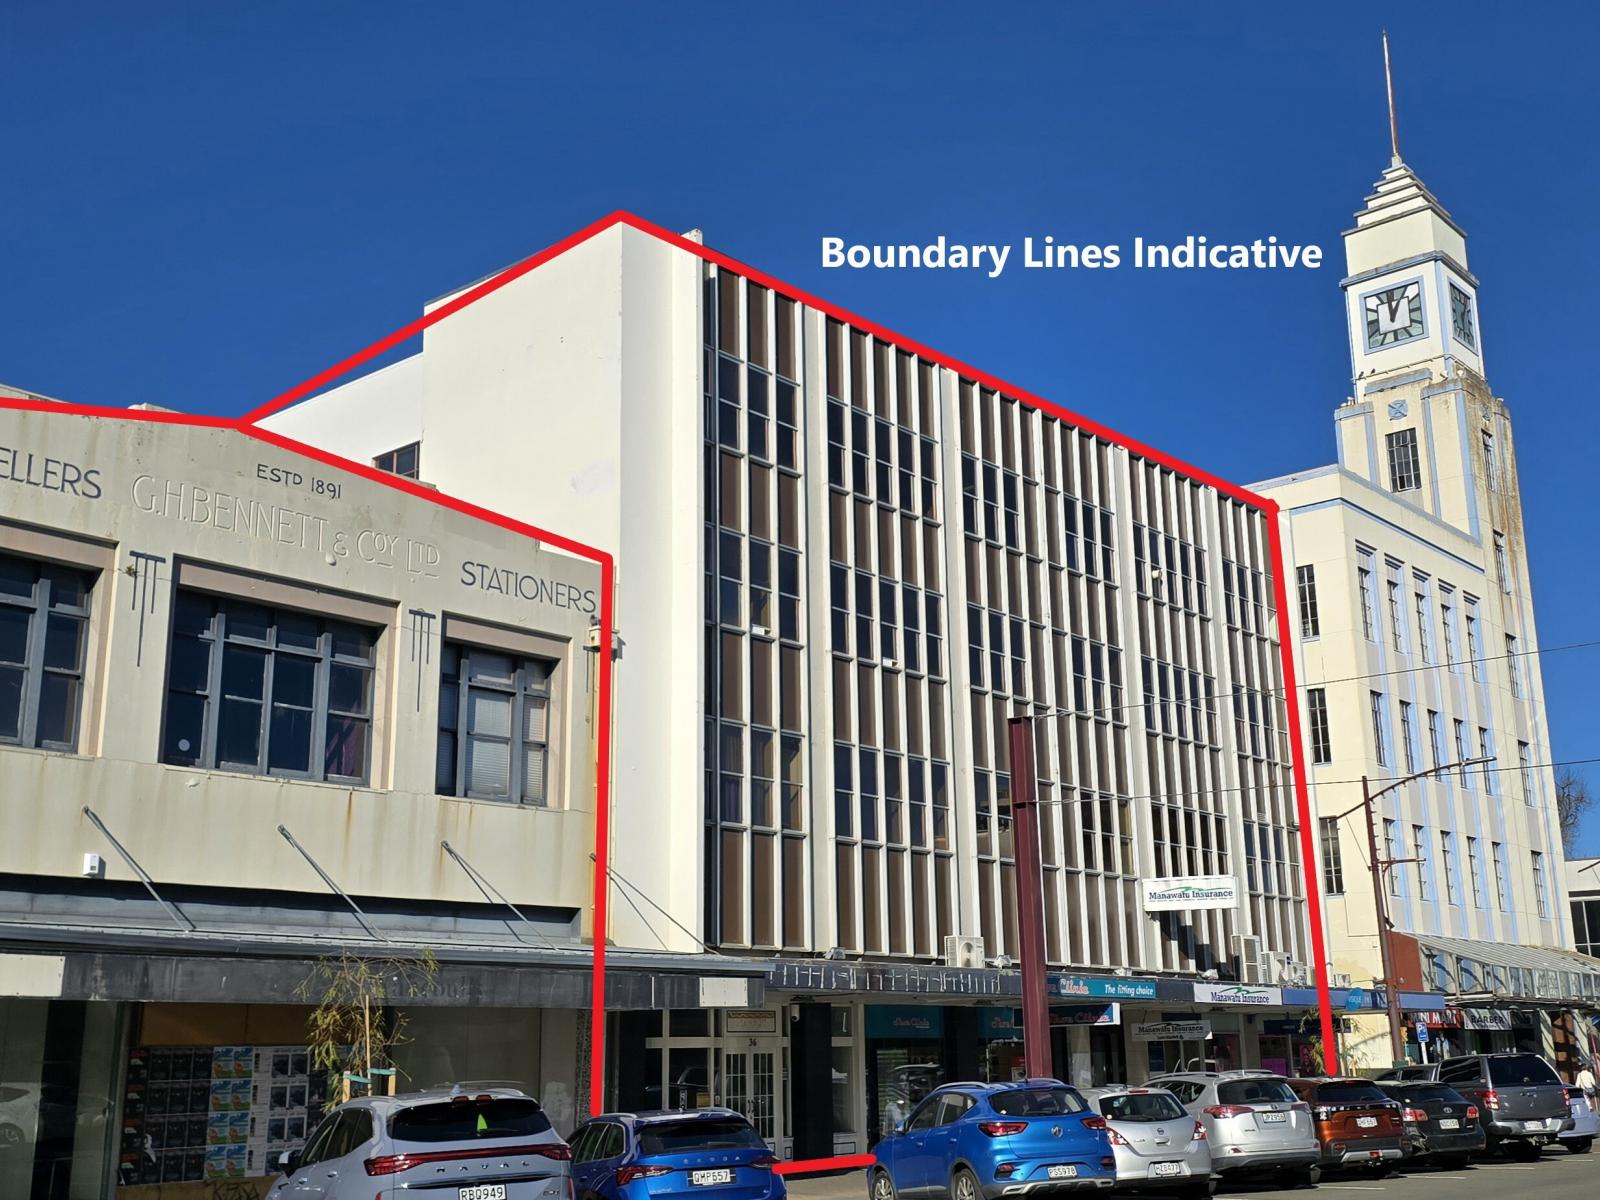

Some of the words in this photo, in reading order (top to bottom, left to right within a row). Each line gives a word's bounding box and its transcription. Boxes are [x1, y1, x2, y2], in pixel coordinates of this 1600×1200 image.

[257, 464, 303, 487] ESTD
[311, 477, 341, 499] 1891
[333, 531, 349, 558] &
[460, 560, 597, 614] STATIONERS
[1148, 891, 1190, 900] Manawatu
[1192, 889, 1233, 898] Insurance
[1105, 984, 1115, 994] The
[1136, 985, 1154, 995] choice
[1211, 991, 1241, 1003] Manawatu
[1242, 993, 1270, 1004] Insurance
[1471, 1014, 1505, 1024] BARBER
[461, 1186, 504, 1200] RBQ949
